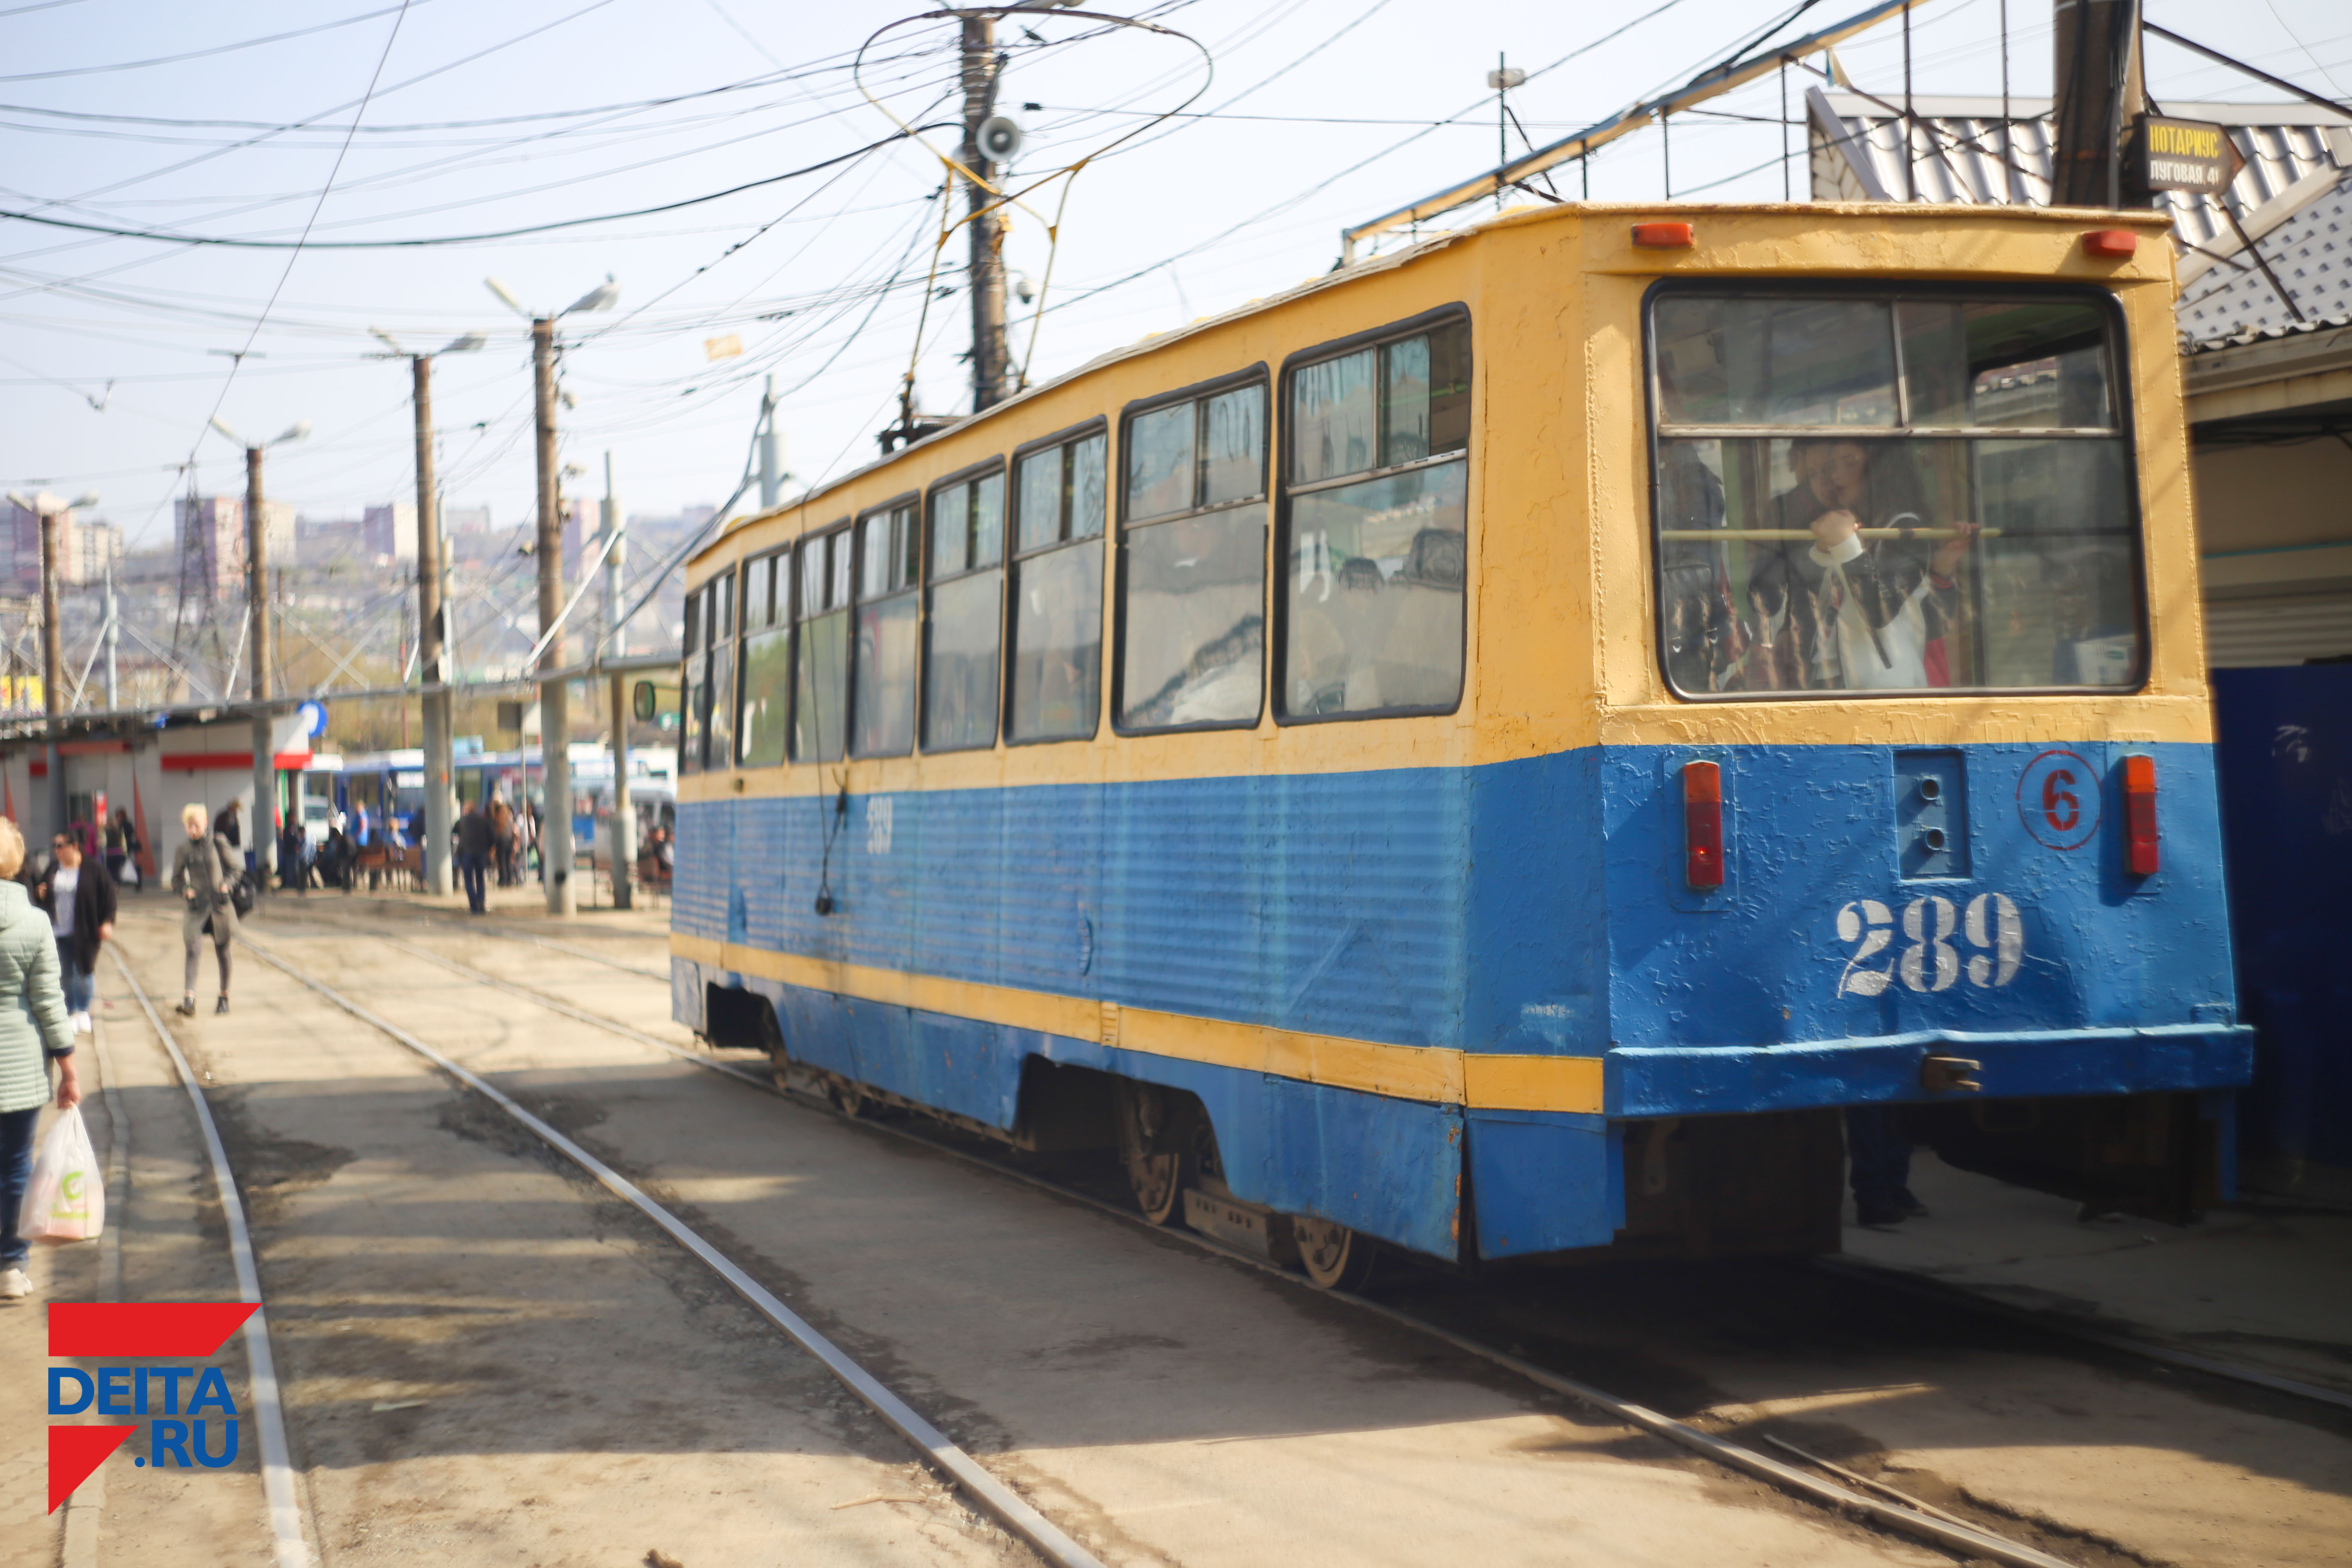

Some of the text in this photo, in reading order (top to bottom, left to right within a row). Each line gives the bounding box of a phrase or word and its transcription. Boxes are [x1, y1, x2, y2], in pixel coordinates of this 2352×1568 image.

[2150, 125, 2219, 159] НОТАРИУС
[2043, 769, 2079, 831] 6
[1837, 892, 2023, 999] 289
